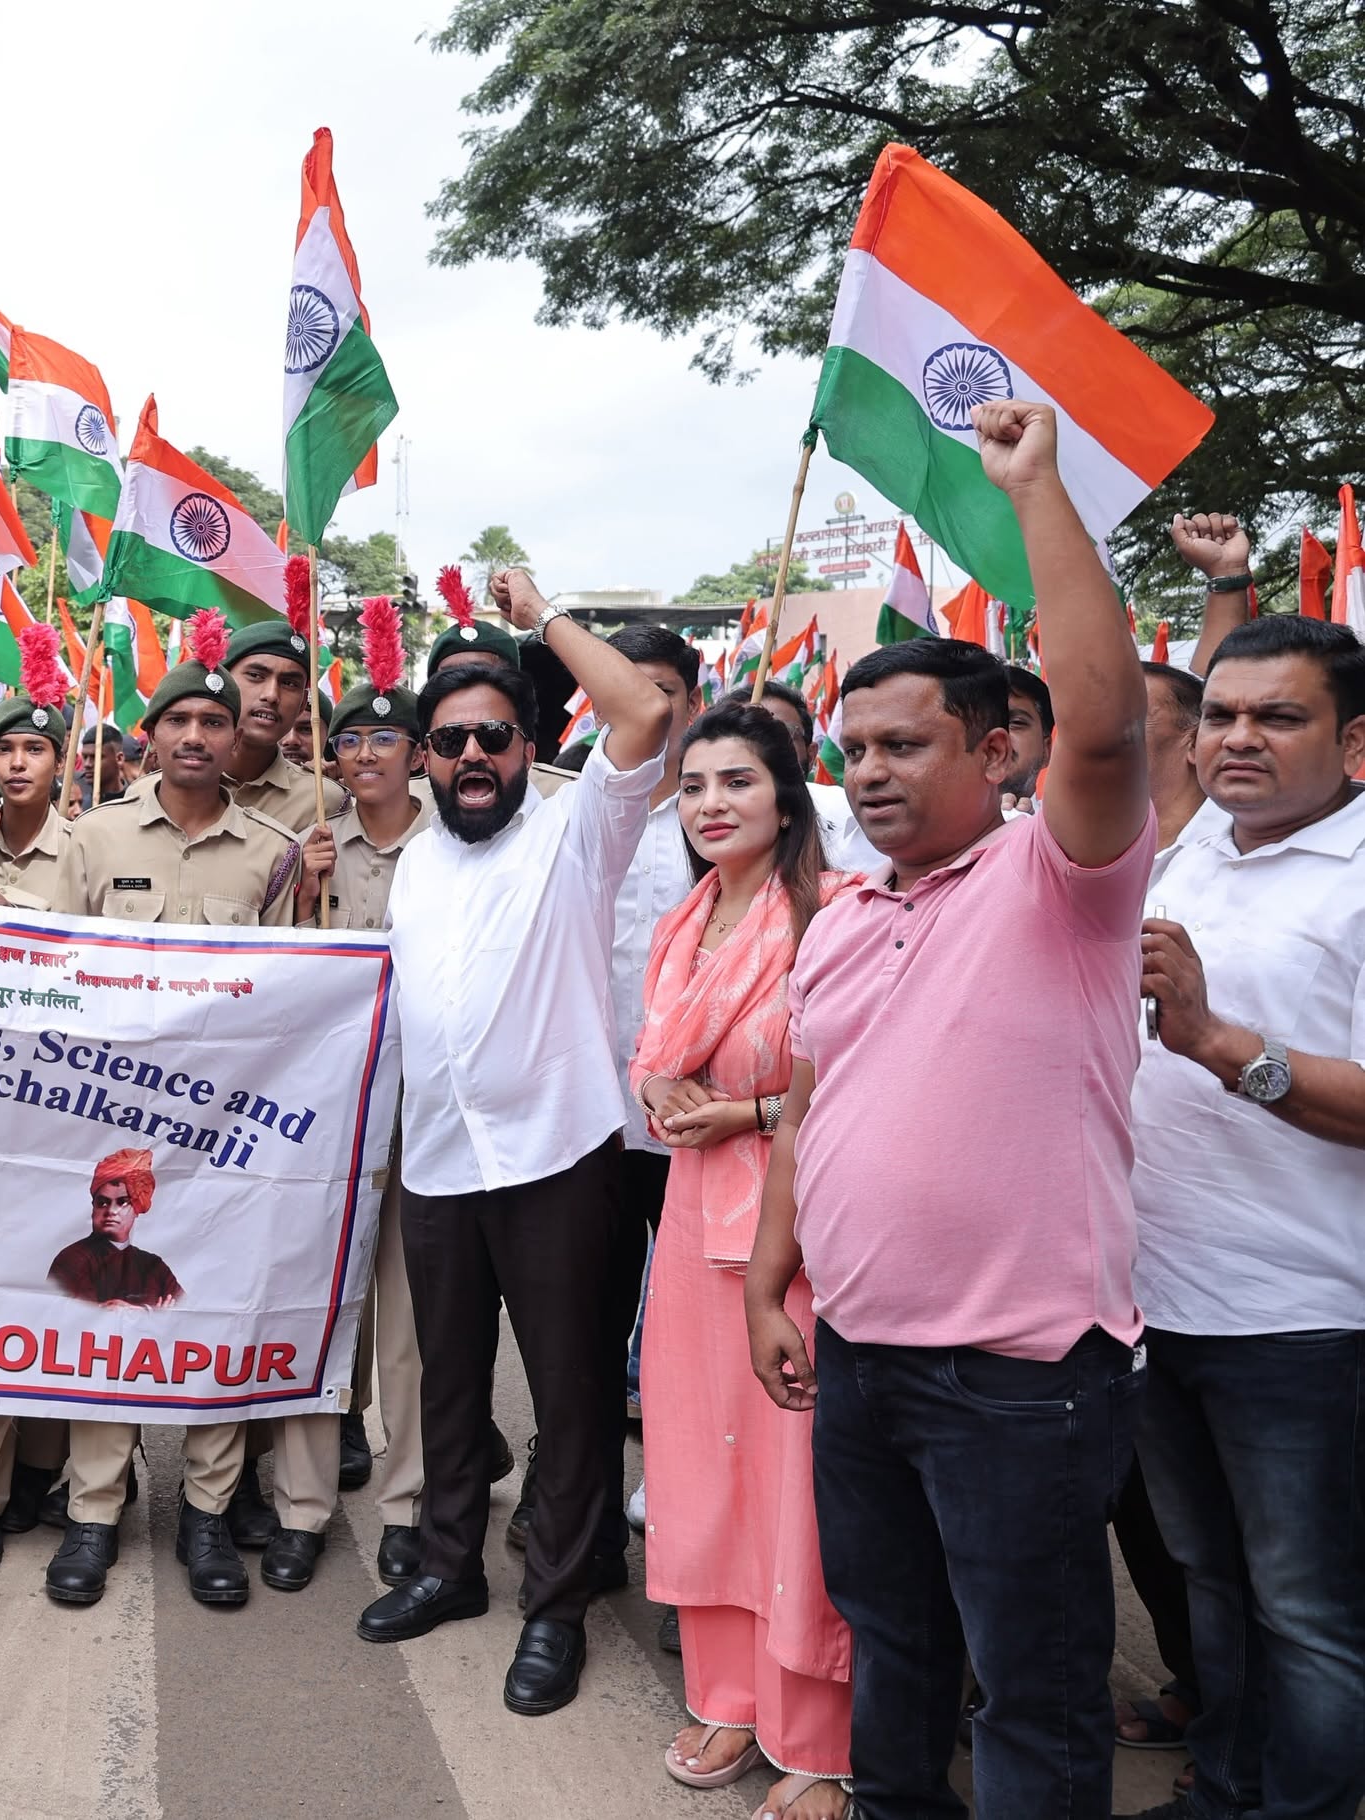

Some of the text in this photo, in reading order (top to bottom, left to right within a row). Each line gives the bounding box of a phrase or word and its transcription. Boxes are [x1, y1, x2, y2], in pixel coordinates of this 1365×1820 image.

[19, 986, 84, 1013] संचलित,
[33, 1029, 215, 1106] Science
[223, 1087, 317, 1145] and
